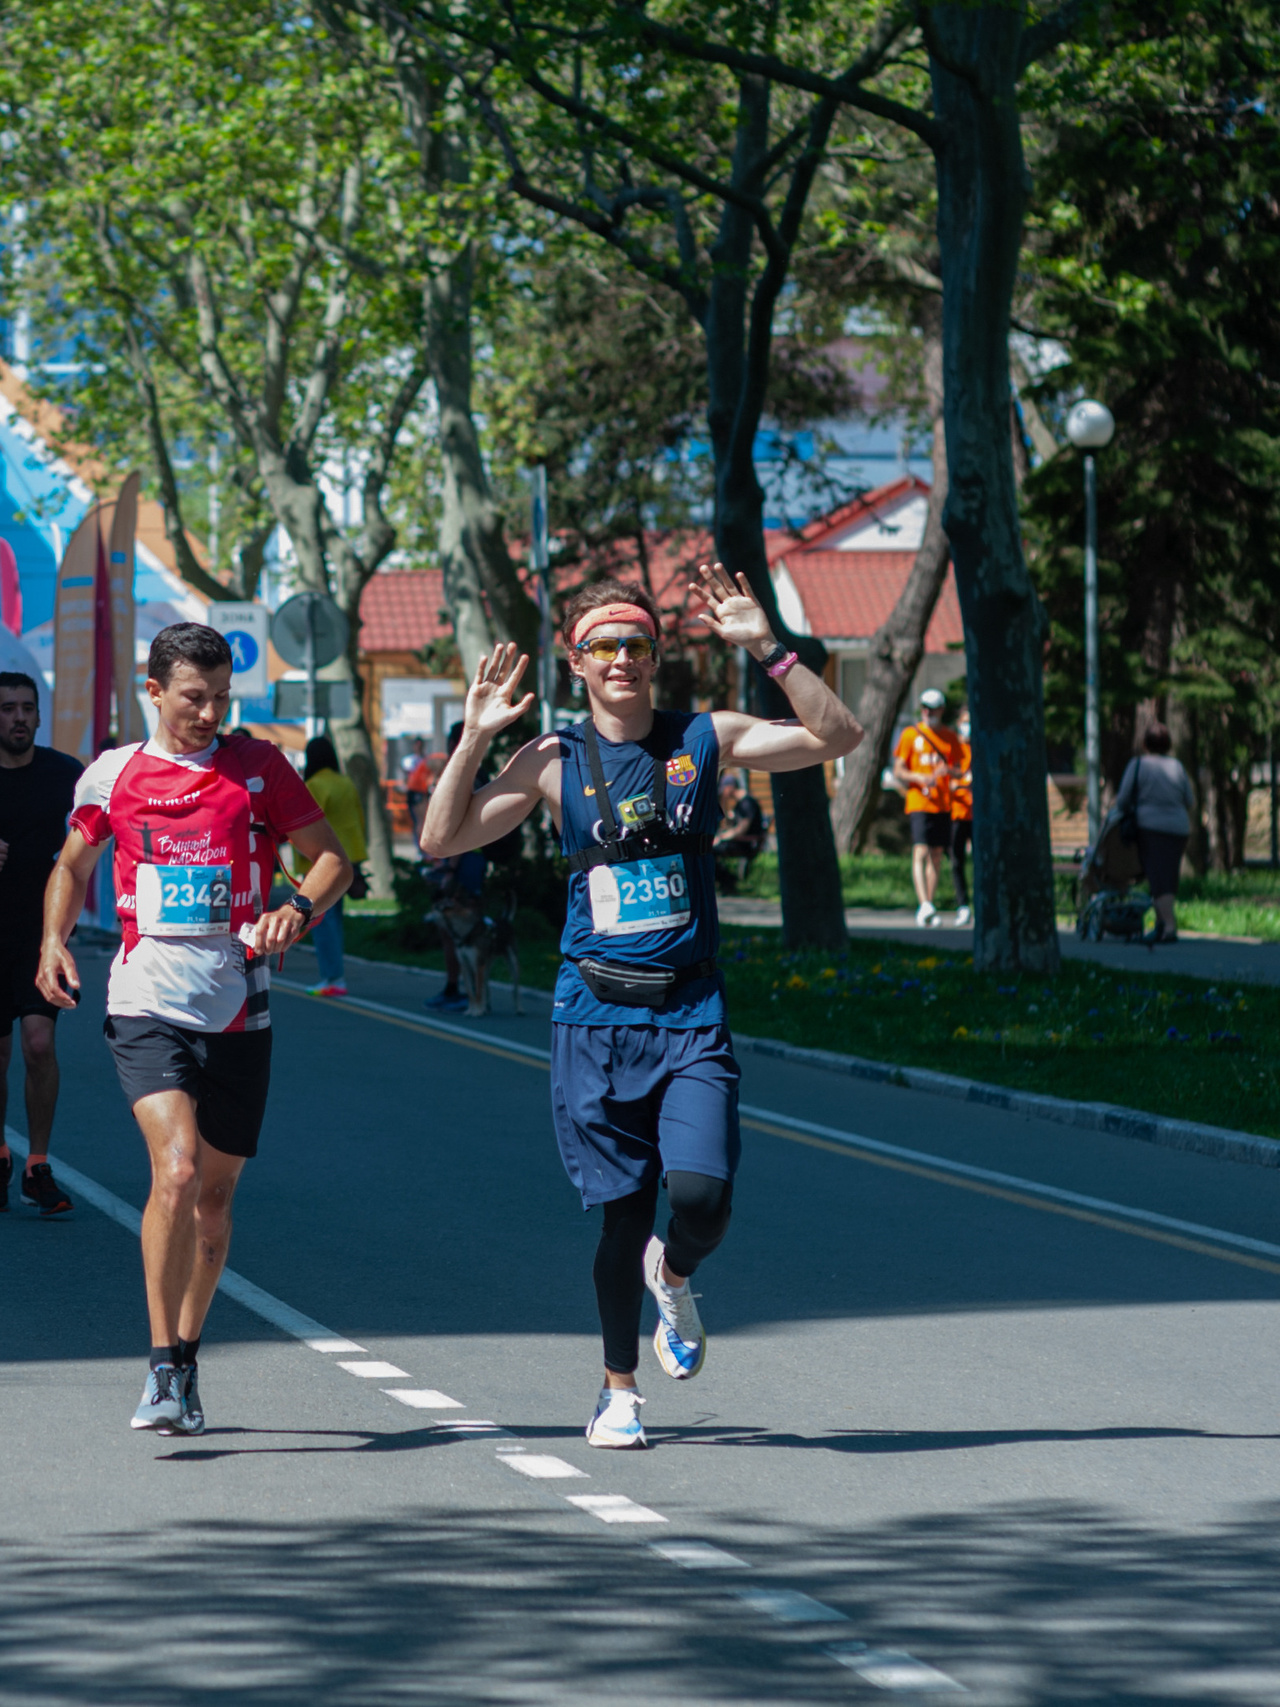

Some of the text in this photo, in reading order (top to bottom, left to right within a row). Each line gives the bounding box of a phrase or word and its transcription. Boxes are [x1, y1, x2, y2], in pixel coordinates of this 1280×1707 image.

[158, 830, 212, 855] Винный
[167, 847, 227, 867] марафон
[163, 882, 228, 908] 2342
[621, 873, 685, 905] 2350
